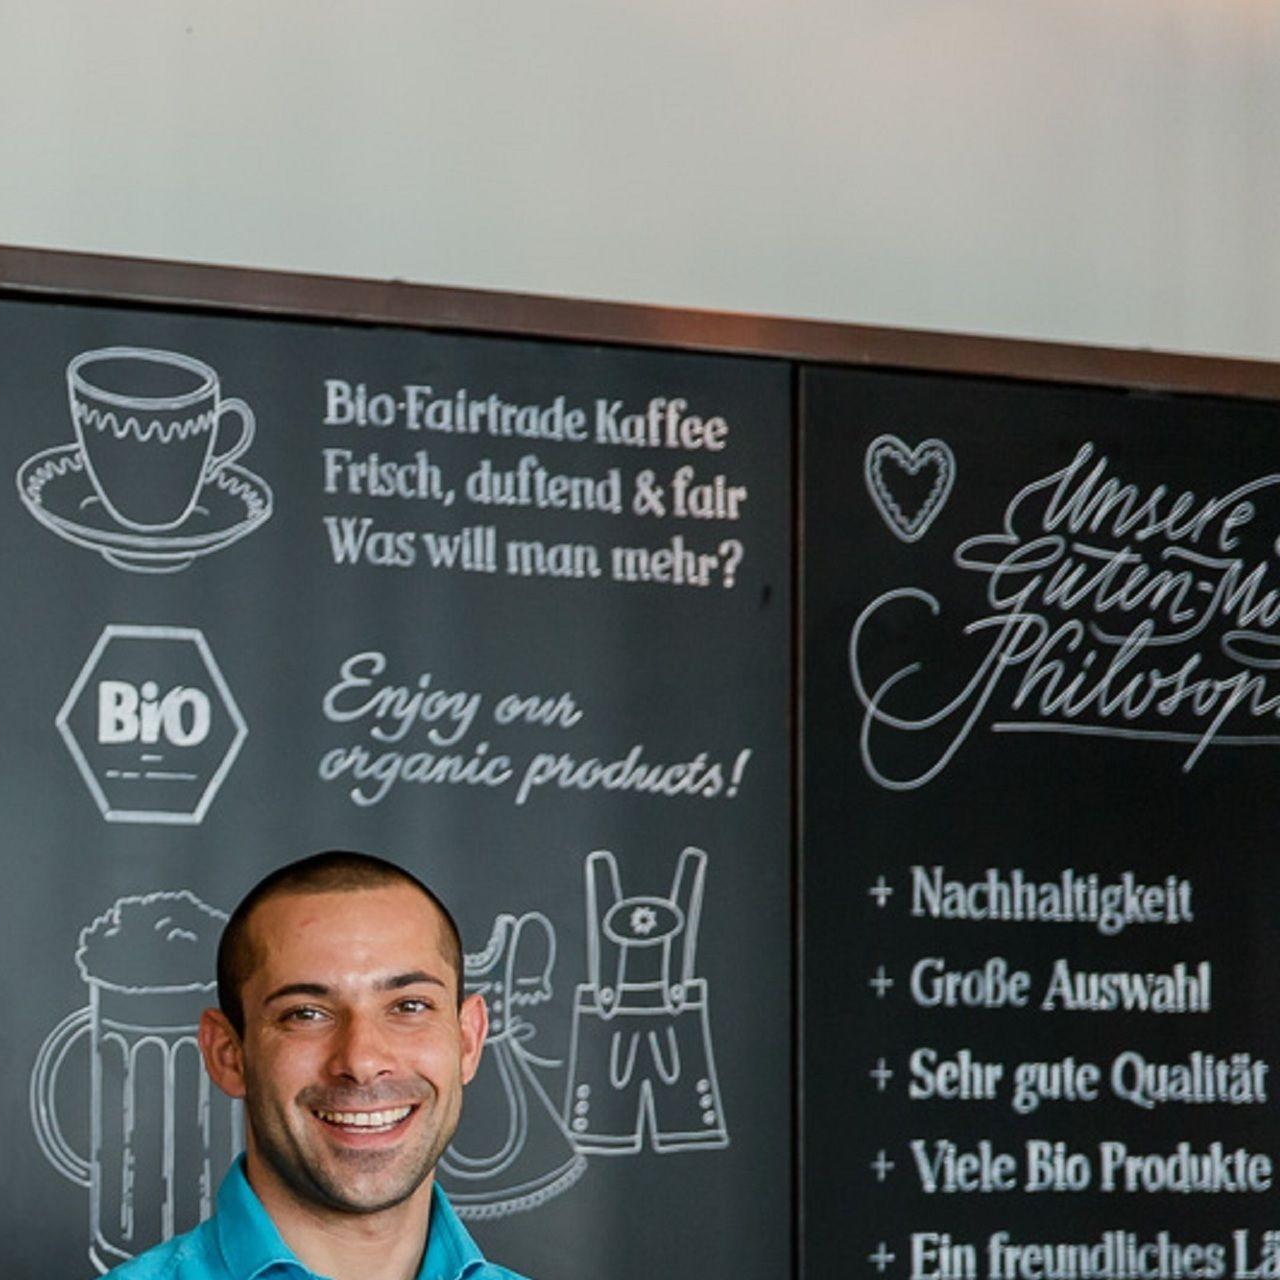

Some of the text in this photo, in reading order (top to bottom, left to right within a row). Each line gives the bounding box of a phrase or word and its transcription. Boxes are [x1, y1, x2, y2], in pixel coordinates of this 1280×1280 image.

[595, 396, 730, 451] Kaffee
[323, 448, 748, 520] Frisch, duftend & fair
[1006, 441, 1262, 551] Unsere
[323, 515, 744, 589] Was will man mehr?
[323, 651, 584, 747] Enjoy our
[860, 613, 1280, 790] Philosop
[319, 741, 752, 806] organic products!
[909, 865, 1195, 936] Nachhaltigkeit
[909, 957, 1032, 1009] Große
[1042, 958, 1212, 1014] Auswahl
[908, 1047, 1004, 1100] Sehr
[1011, 1056, 1100, 1114] gute
[1110, 1050, 1268, 1110] Qualität
[909, 1139, 1017, 1194] Viele
[1025, 1138, 1091, 1192] Bio
[1099, 1140, 1273, 1194] Produkte
